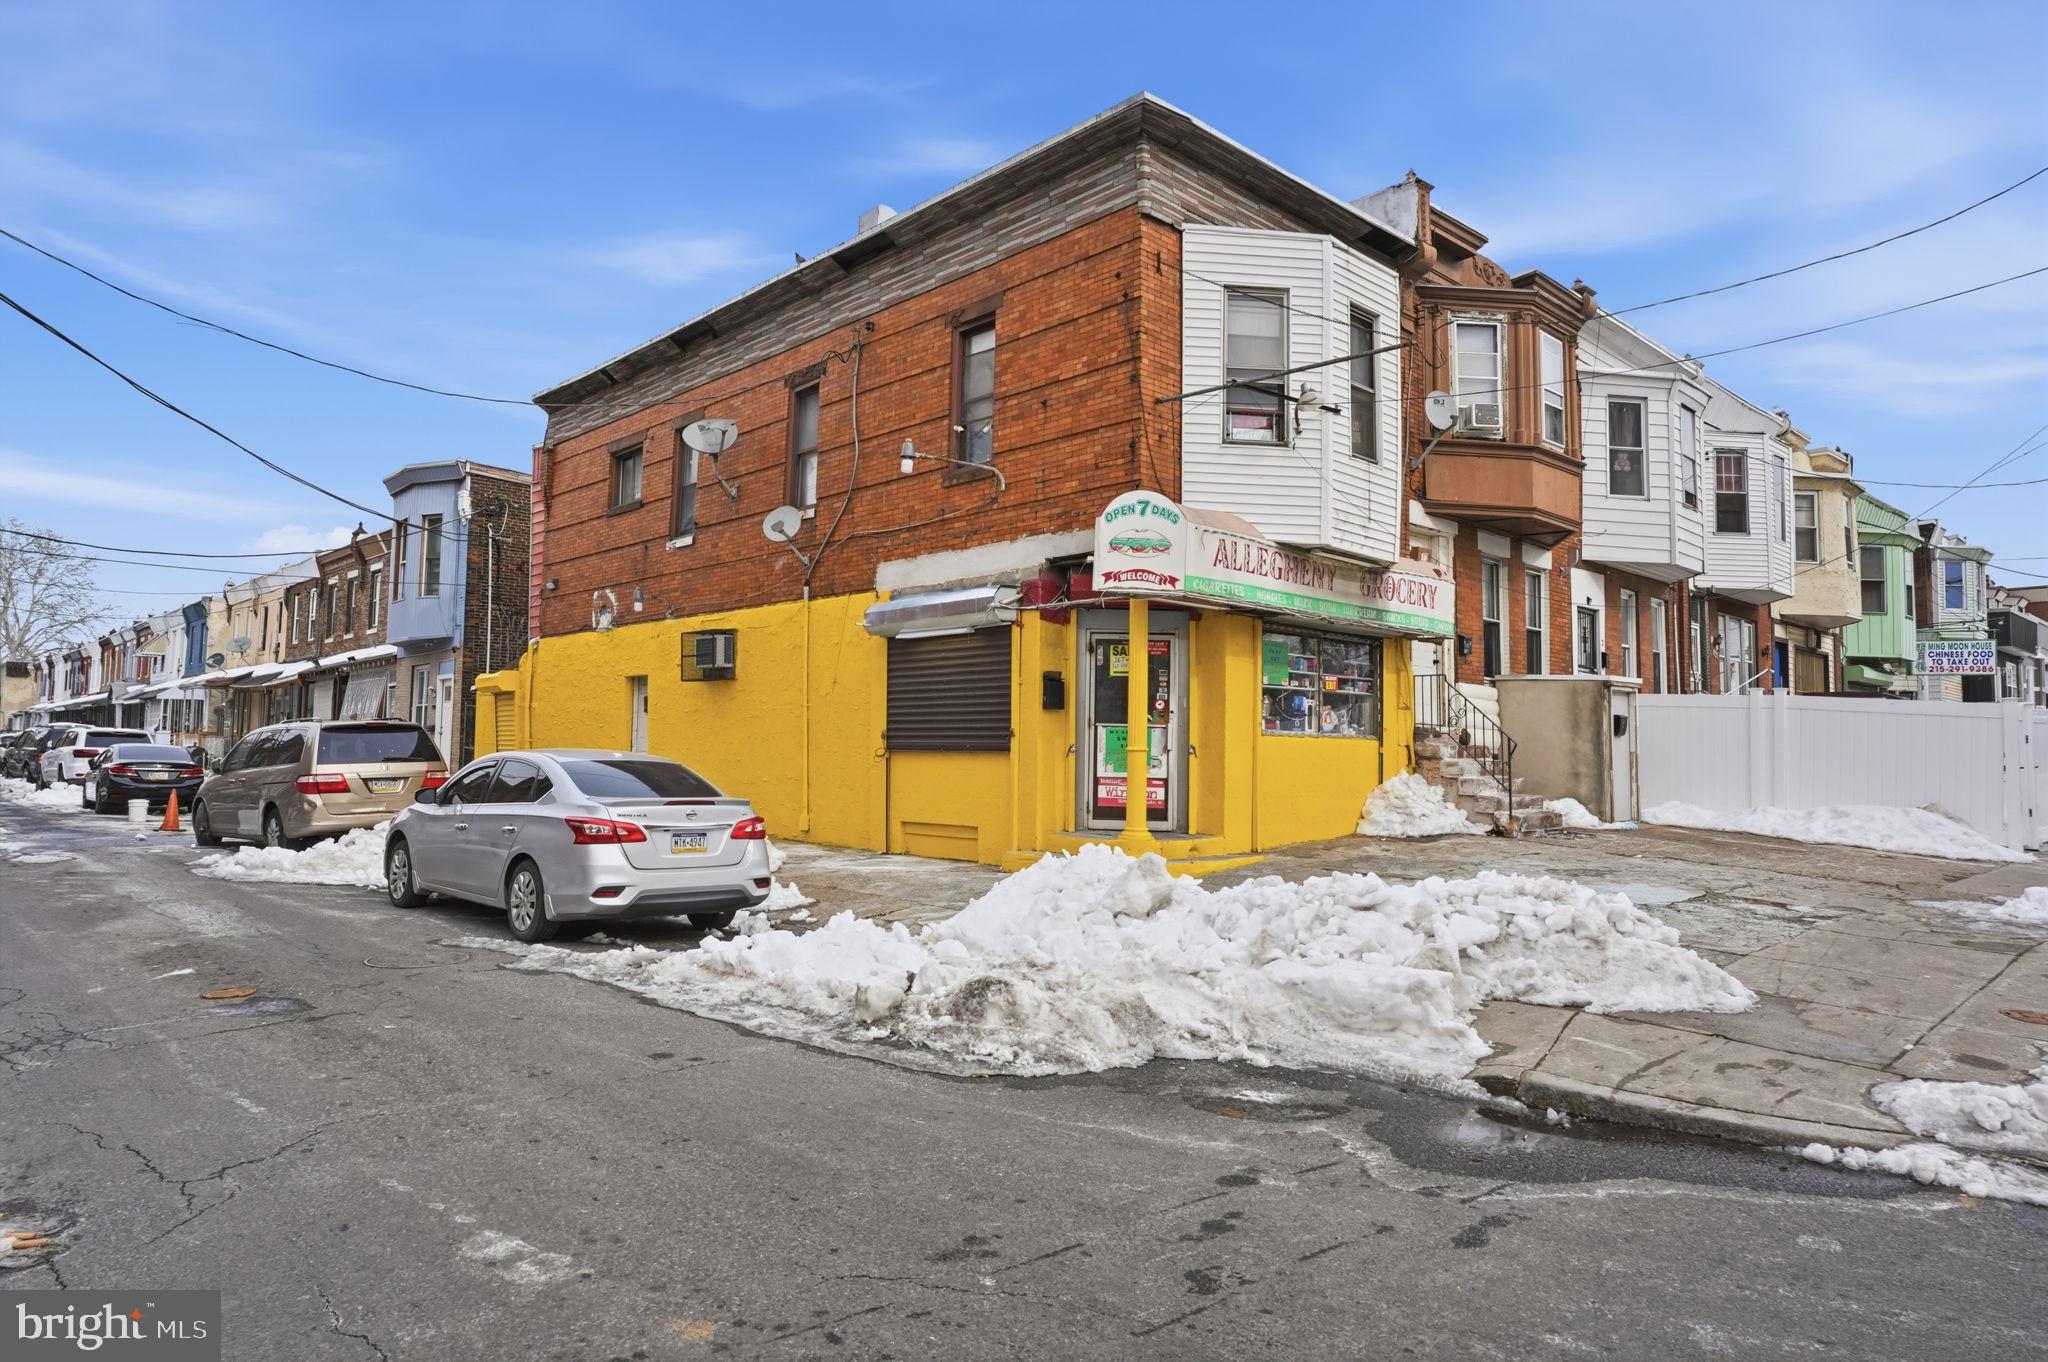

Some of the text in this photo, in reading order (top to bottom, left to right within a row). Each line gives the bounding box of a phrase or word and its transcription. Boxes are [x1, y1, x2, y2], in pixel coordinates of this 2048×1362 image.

[1105, 499, 1180, 525] OPEN 7 DAYS
[1119, 571, 1161, 584] WELCOME
[1212, 538, 1438, 609] ALLEGHENY GROCERY
[1193, 579, 1245, 597] CIGARETTES
[1112, 645, 1130, 656] SA
[1928, 642, 1992, 651] MING MOON HOUSE
[1967, 650, 1994, 658] FOOD
[1931, 658, 1990, 666] TO TAKE OUT
